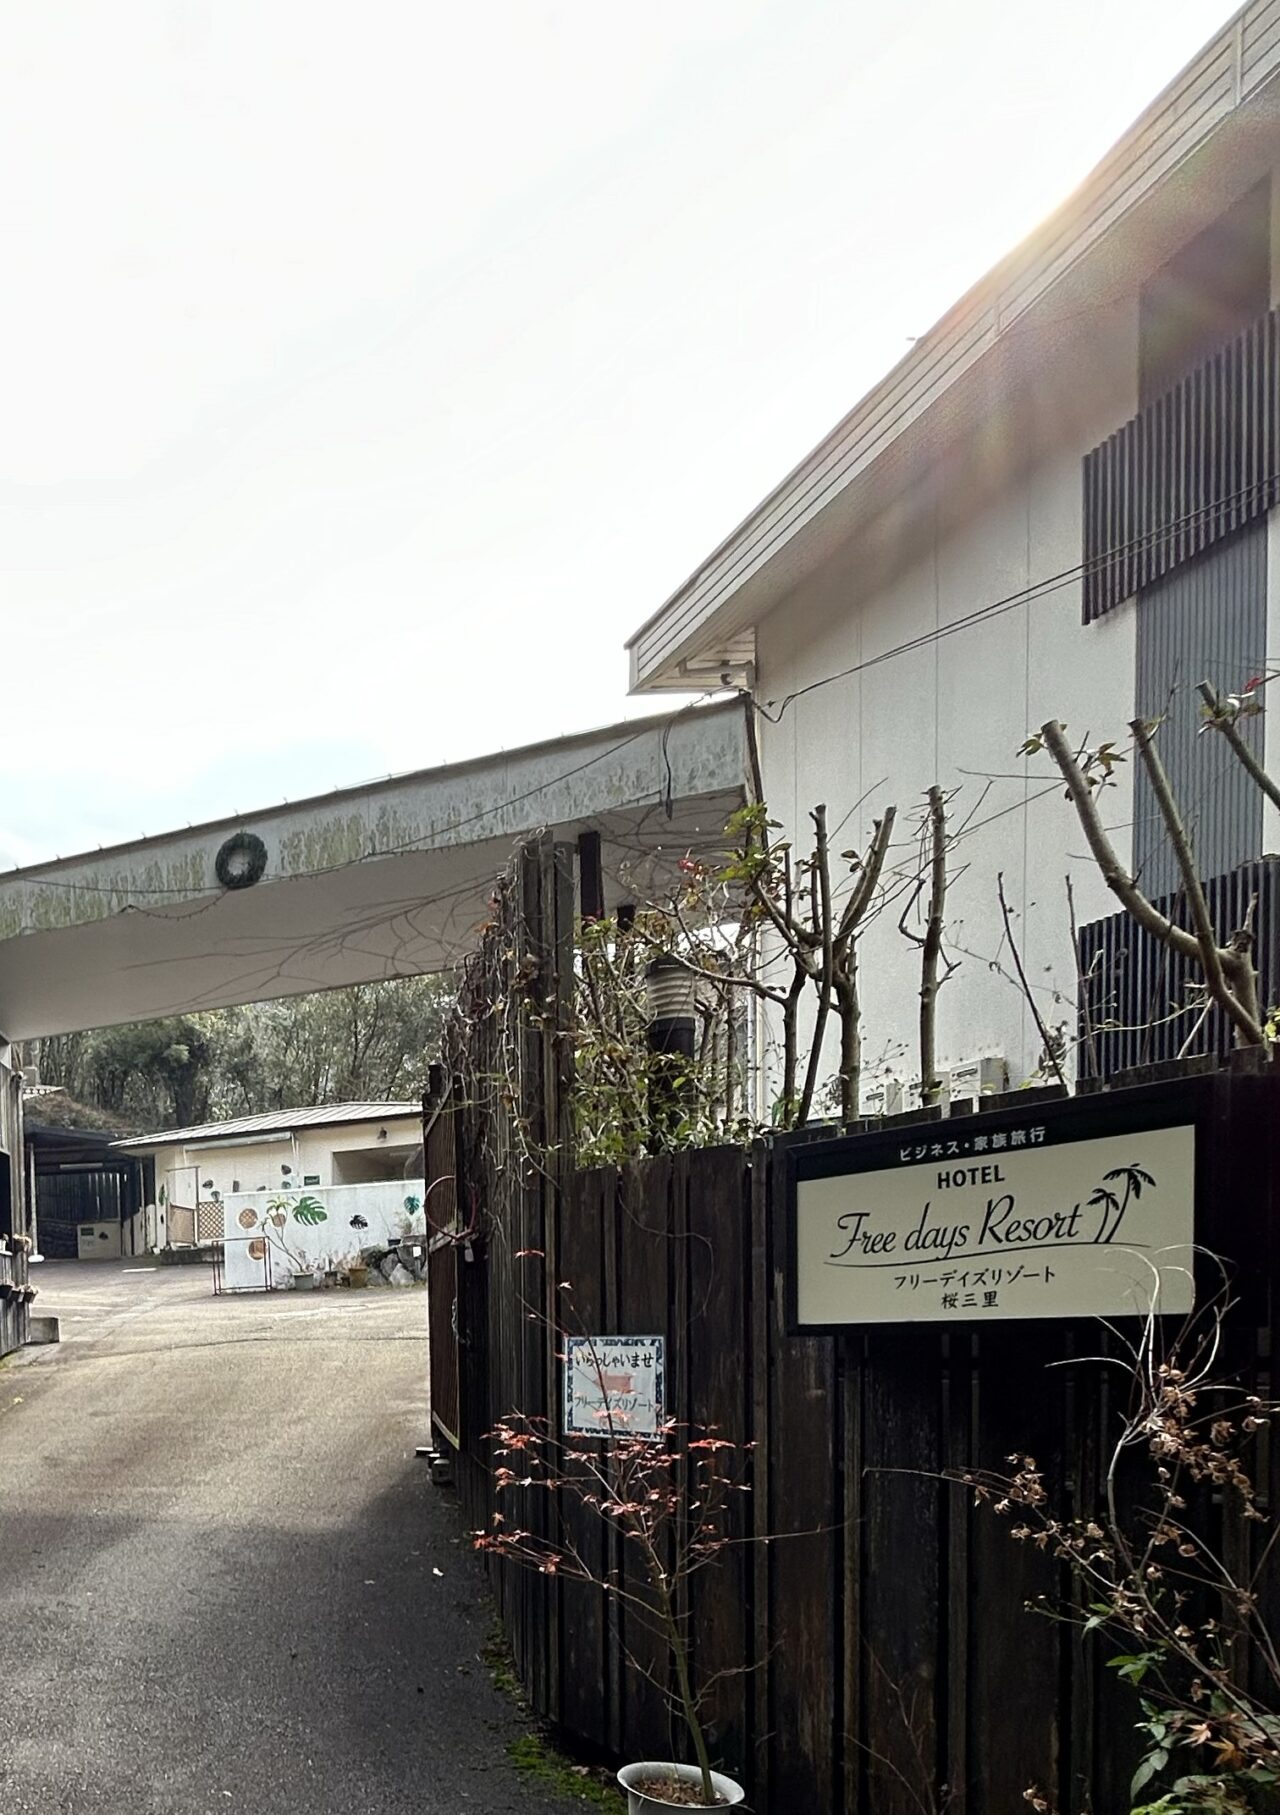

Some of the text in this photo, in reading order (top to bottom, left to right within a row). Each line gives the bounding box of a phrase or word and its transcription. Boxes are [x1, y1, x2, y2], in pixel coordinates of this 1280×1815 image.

[899, 1126, 1046, 1161] ビジネス・家族旅行
[937, 1164, 1005, 1190] HOTEL
[830, 1194, 1083, 1261] Free days Resort
[893, 1265, 1056, 1290] フリーデイズリゾート
[941, 1291, 999, 1309] 桜三里
[575, 1352, 654, 1369] いらっしゃいませ
